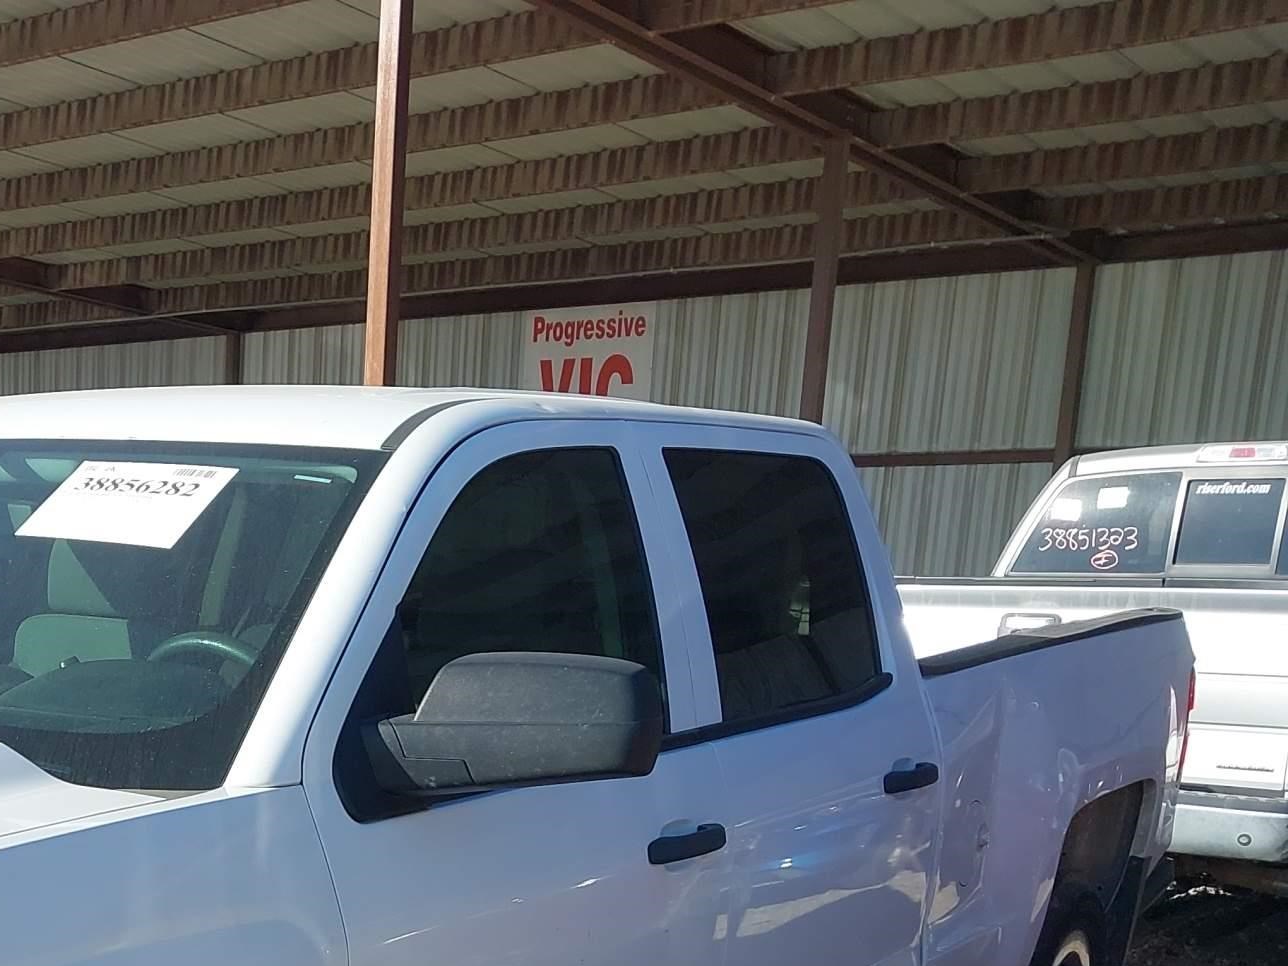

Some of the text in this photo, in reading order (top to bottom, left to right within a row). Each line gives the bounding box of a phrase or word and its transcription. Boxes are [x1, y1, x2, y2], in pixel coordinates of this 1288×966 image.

[533, 310, 646, 346] Progressive
[73, 477, 201, 497] 38856282
[1038, 526, 1138, 551] 38851323
